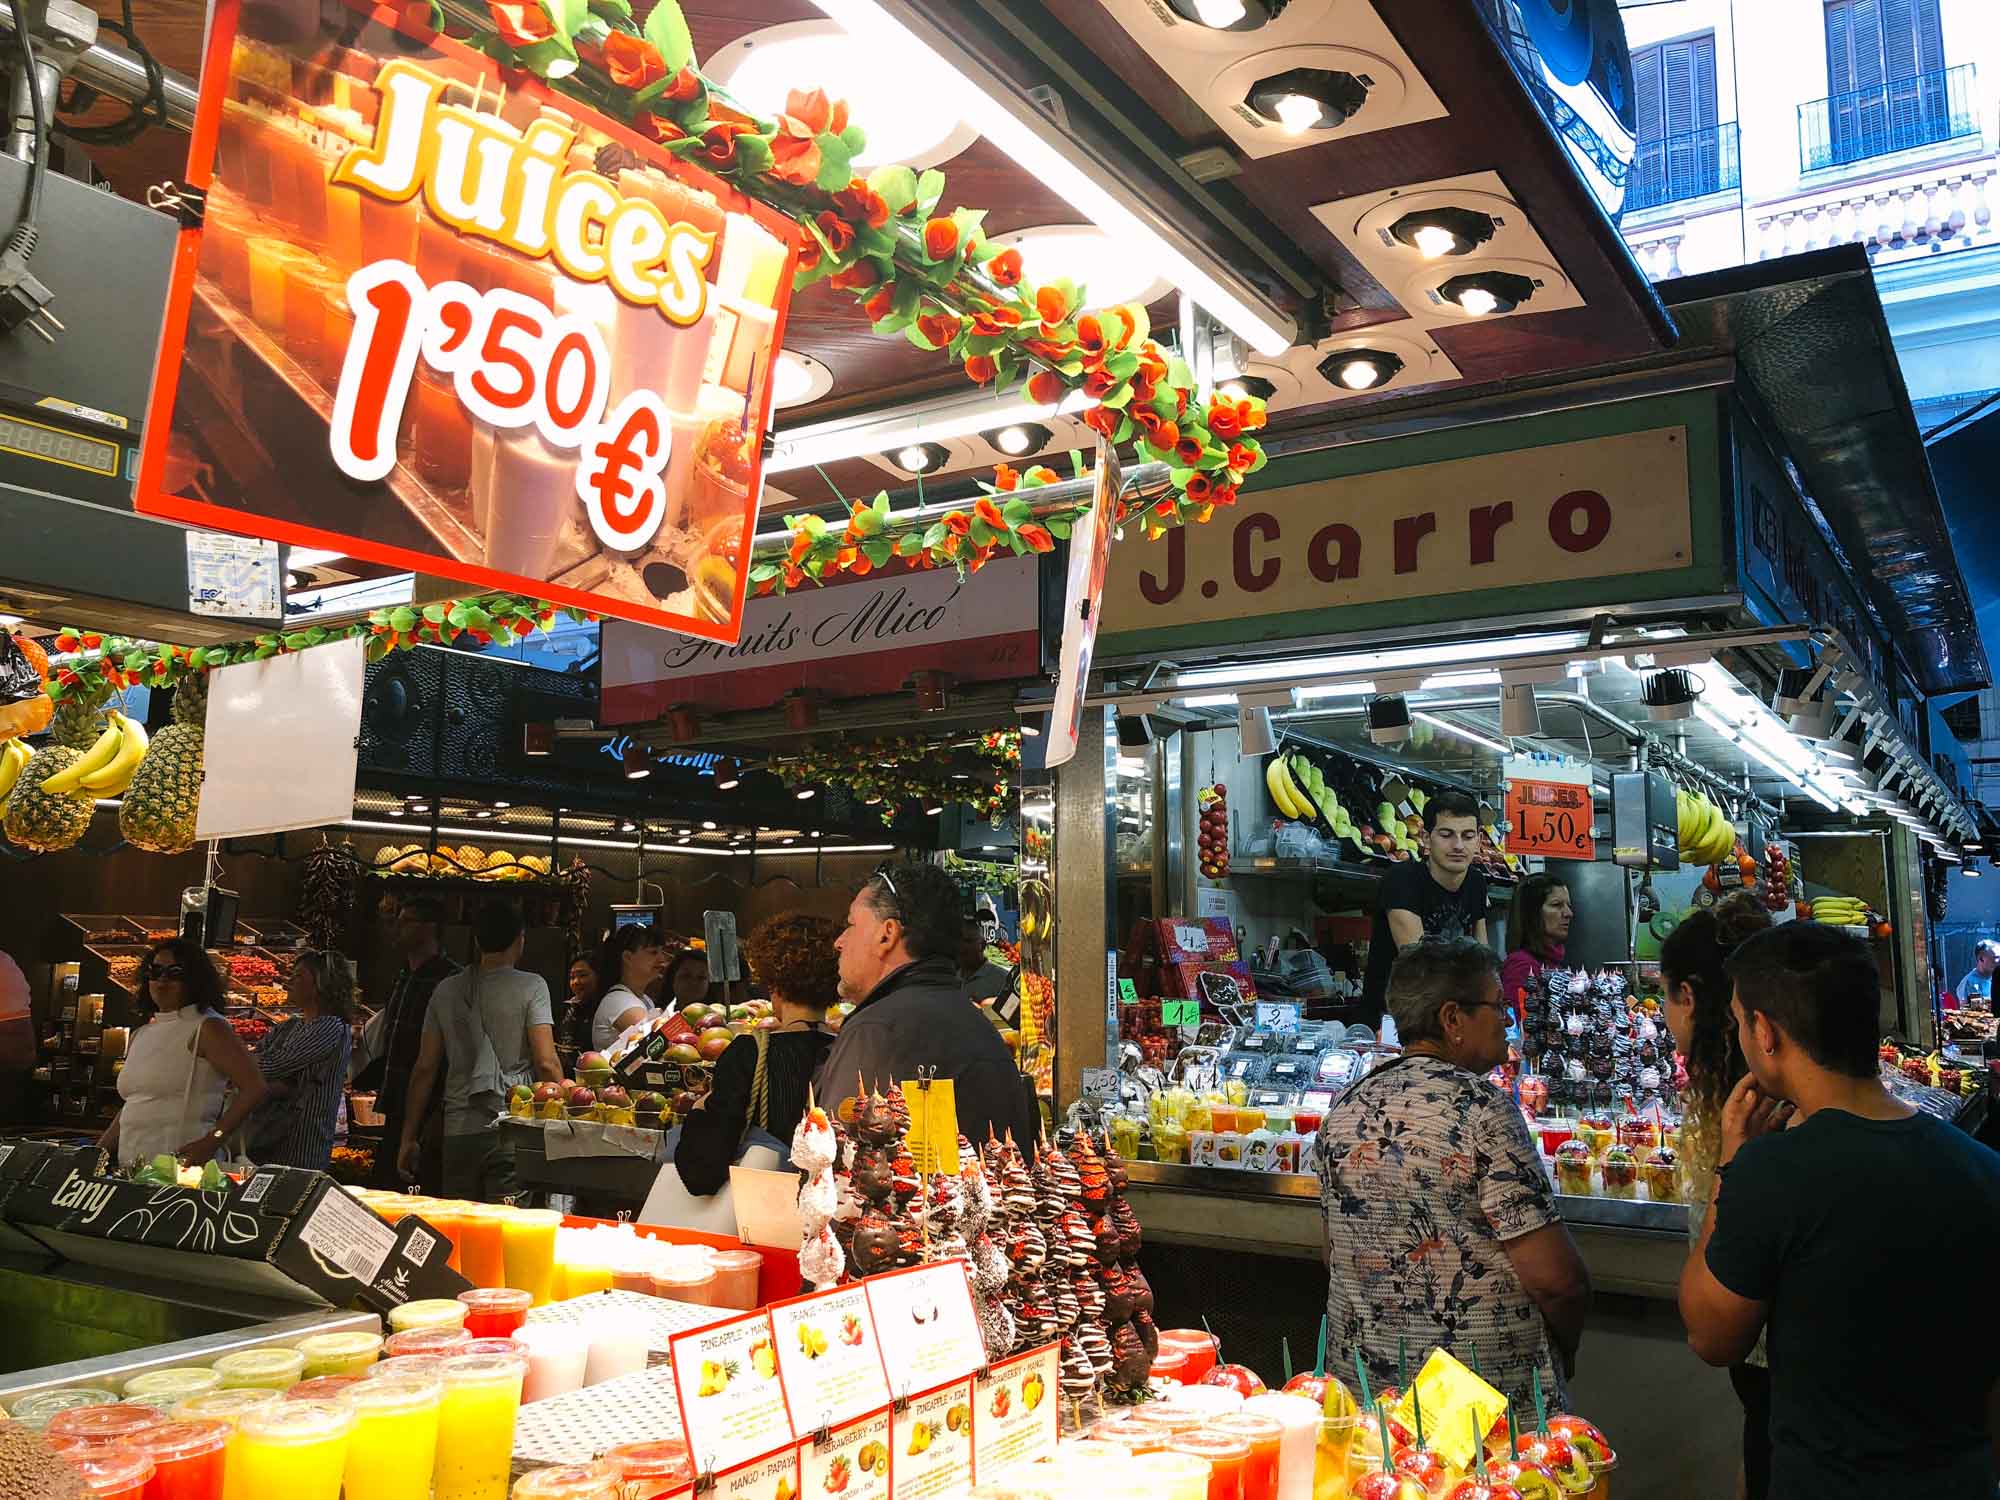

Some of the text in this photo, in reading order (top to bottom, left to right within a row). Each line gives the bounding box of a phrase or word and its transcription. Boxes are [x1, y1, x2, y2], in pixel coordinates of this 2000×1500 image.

[335, 62, 716, 324] Juices
[811, 585, 962, 647] Micó
[51, 1168, 118, 1224] tany
[700, 1328, 742, 1352] PINEAPPLE
[823, 1427, 869, 1454] STRAWBERRY
[730, 1455, 797, 1492] MANGO PAPAYA
